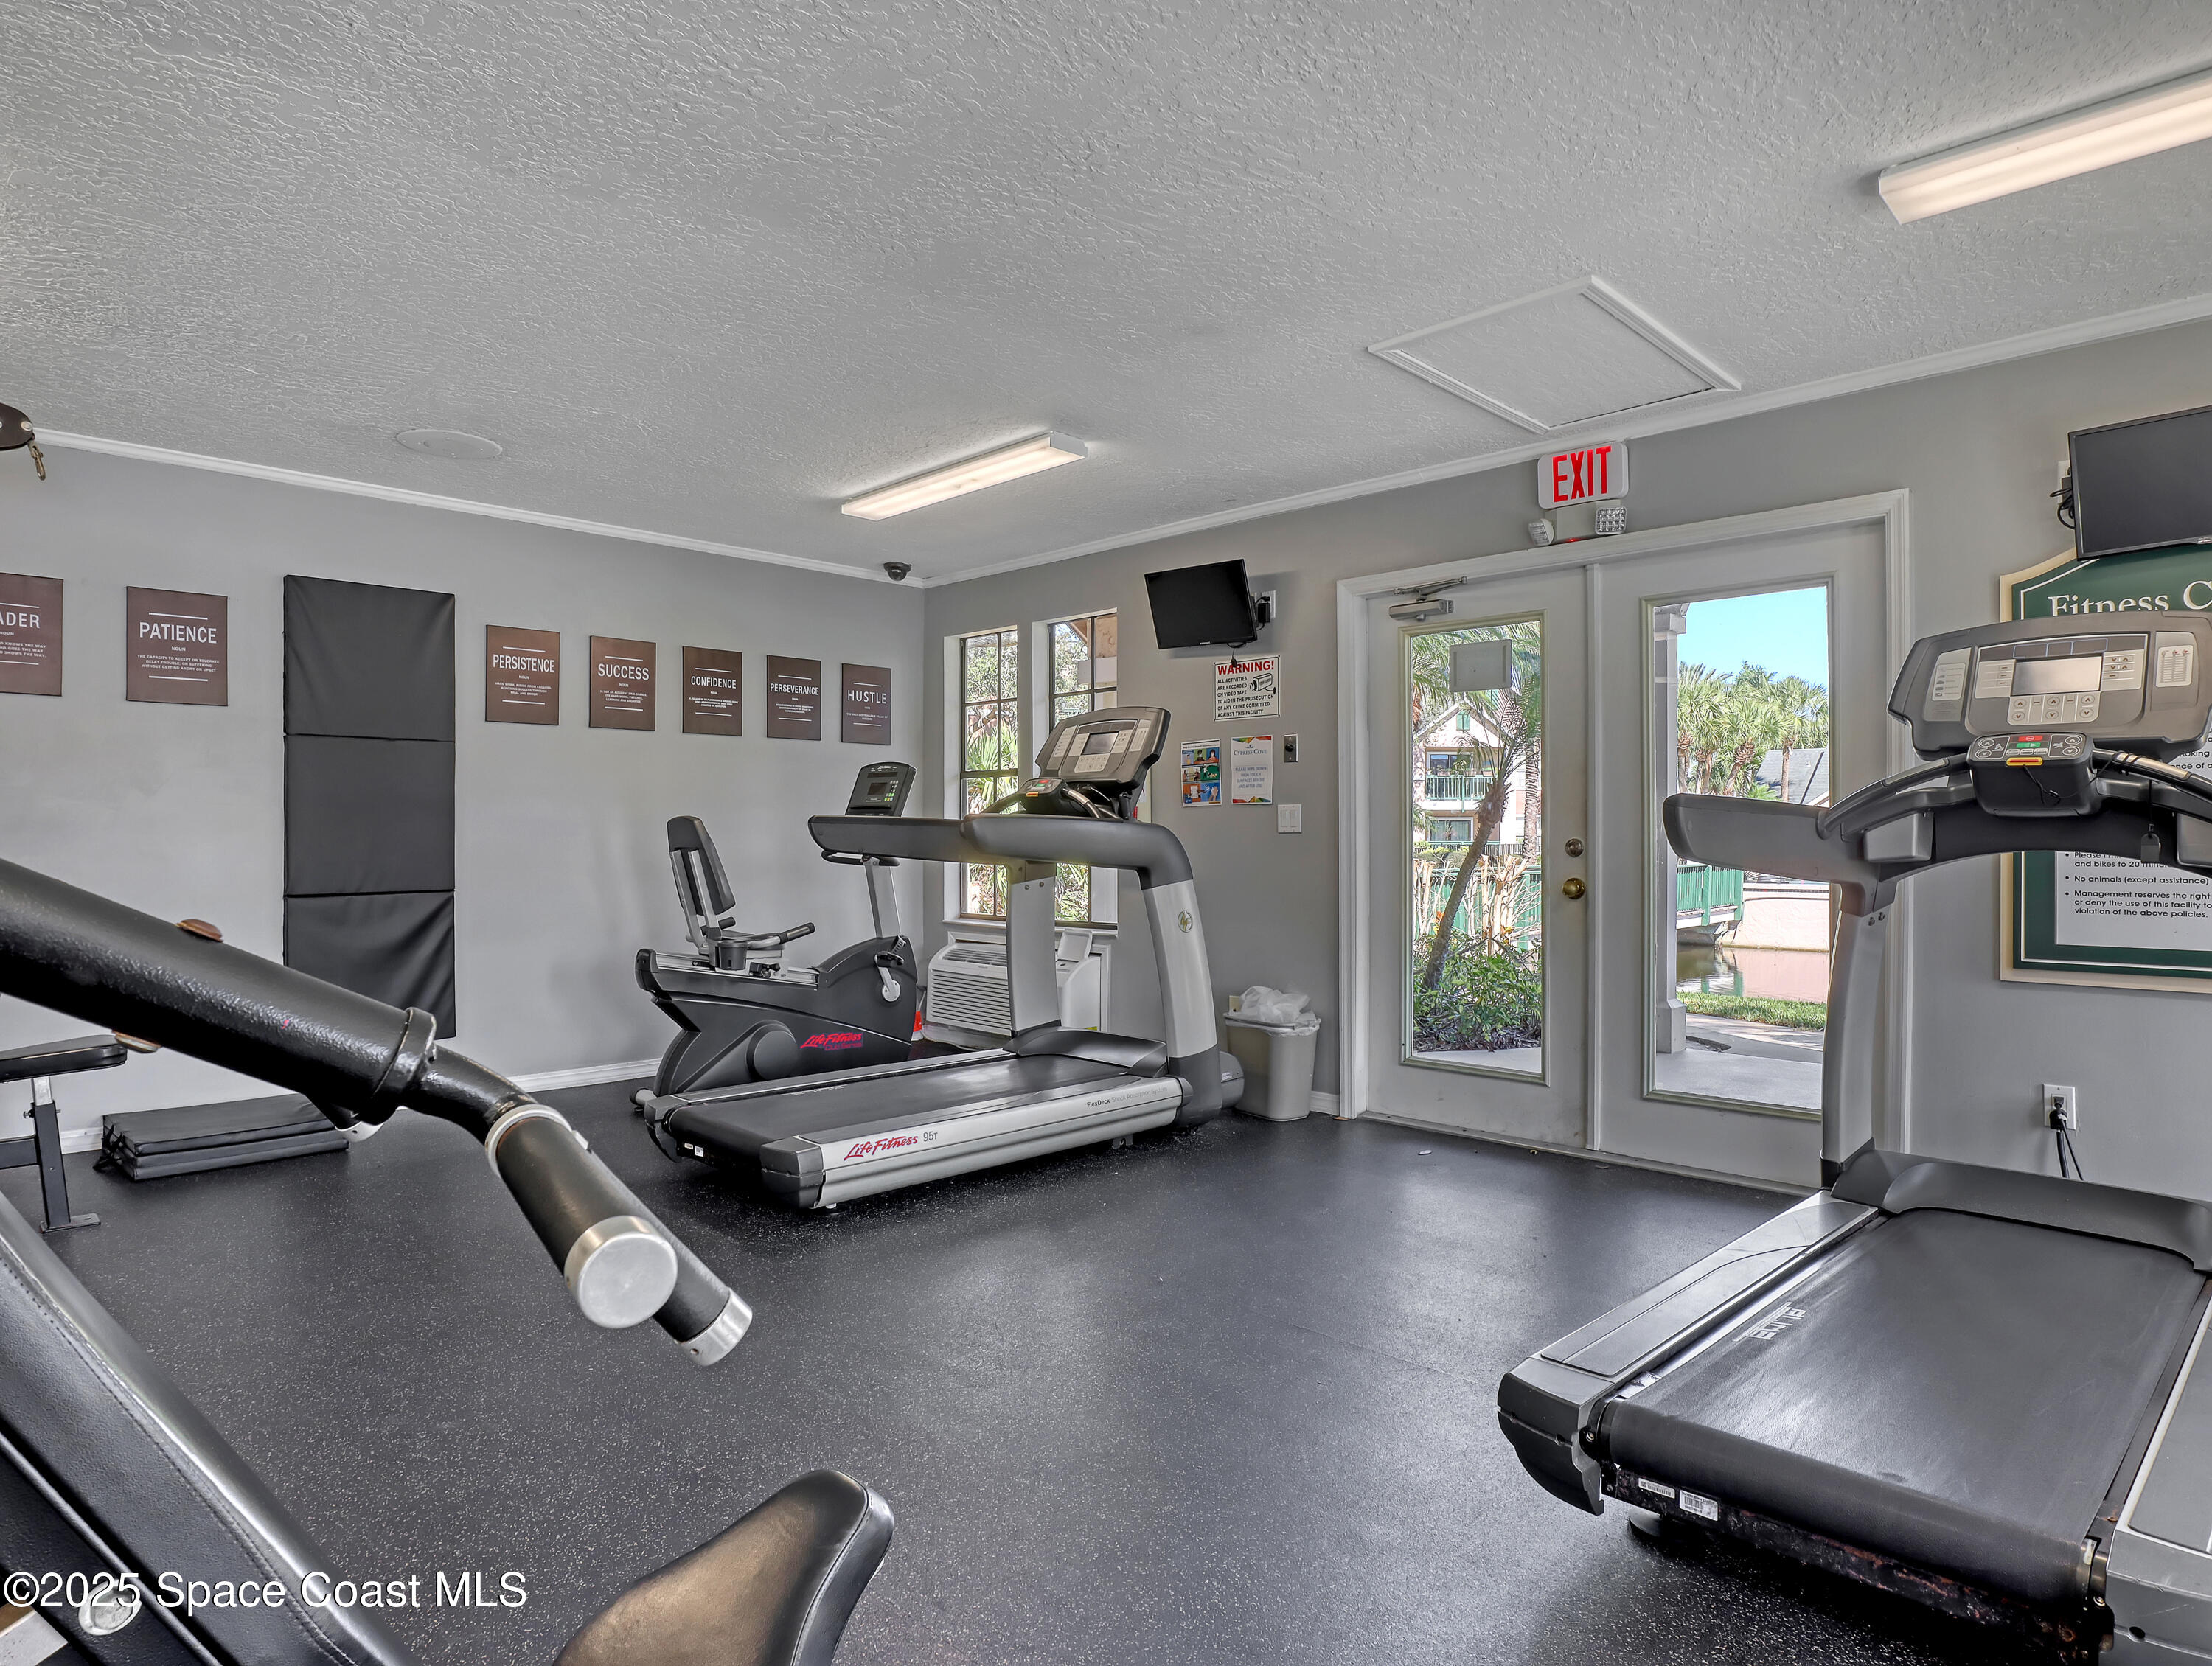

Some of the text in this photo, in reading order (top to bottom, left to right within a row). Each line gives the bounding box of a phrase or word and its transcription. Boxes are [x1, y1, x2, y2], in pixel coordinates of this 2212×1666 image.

[1552, 446, 1612, 502] EXIT
[2048, 594, 2169, 616] Fitness
[139, 621, 217, 644] PATIENCE
[493, 654, 555, 673] PERSISTENCE
[1217, 660, 1274, 675] WARNING!
[598, 663, 650, 680] SUCCESS
[691, 676, 737, 689] CONFIDENCE
[770, 683, 819, 695] PERSEVERANCE
[848, 690, 887, 704] HUSTLE
[2159, 877, 2209, 885] assistance)
[2074, 890, 2132, 899] Management
[2190, 893, 2211, 901] right
[2171, 902, 2201, 910] facility
[799, 1032, 862, 1049] Life Fitness
[1087, 1098, 1110, 1108] FlexDeck
[844, 1141, 873, 1161] Life
[871, 1136, 919, 1155] Fitness
